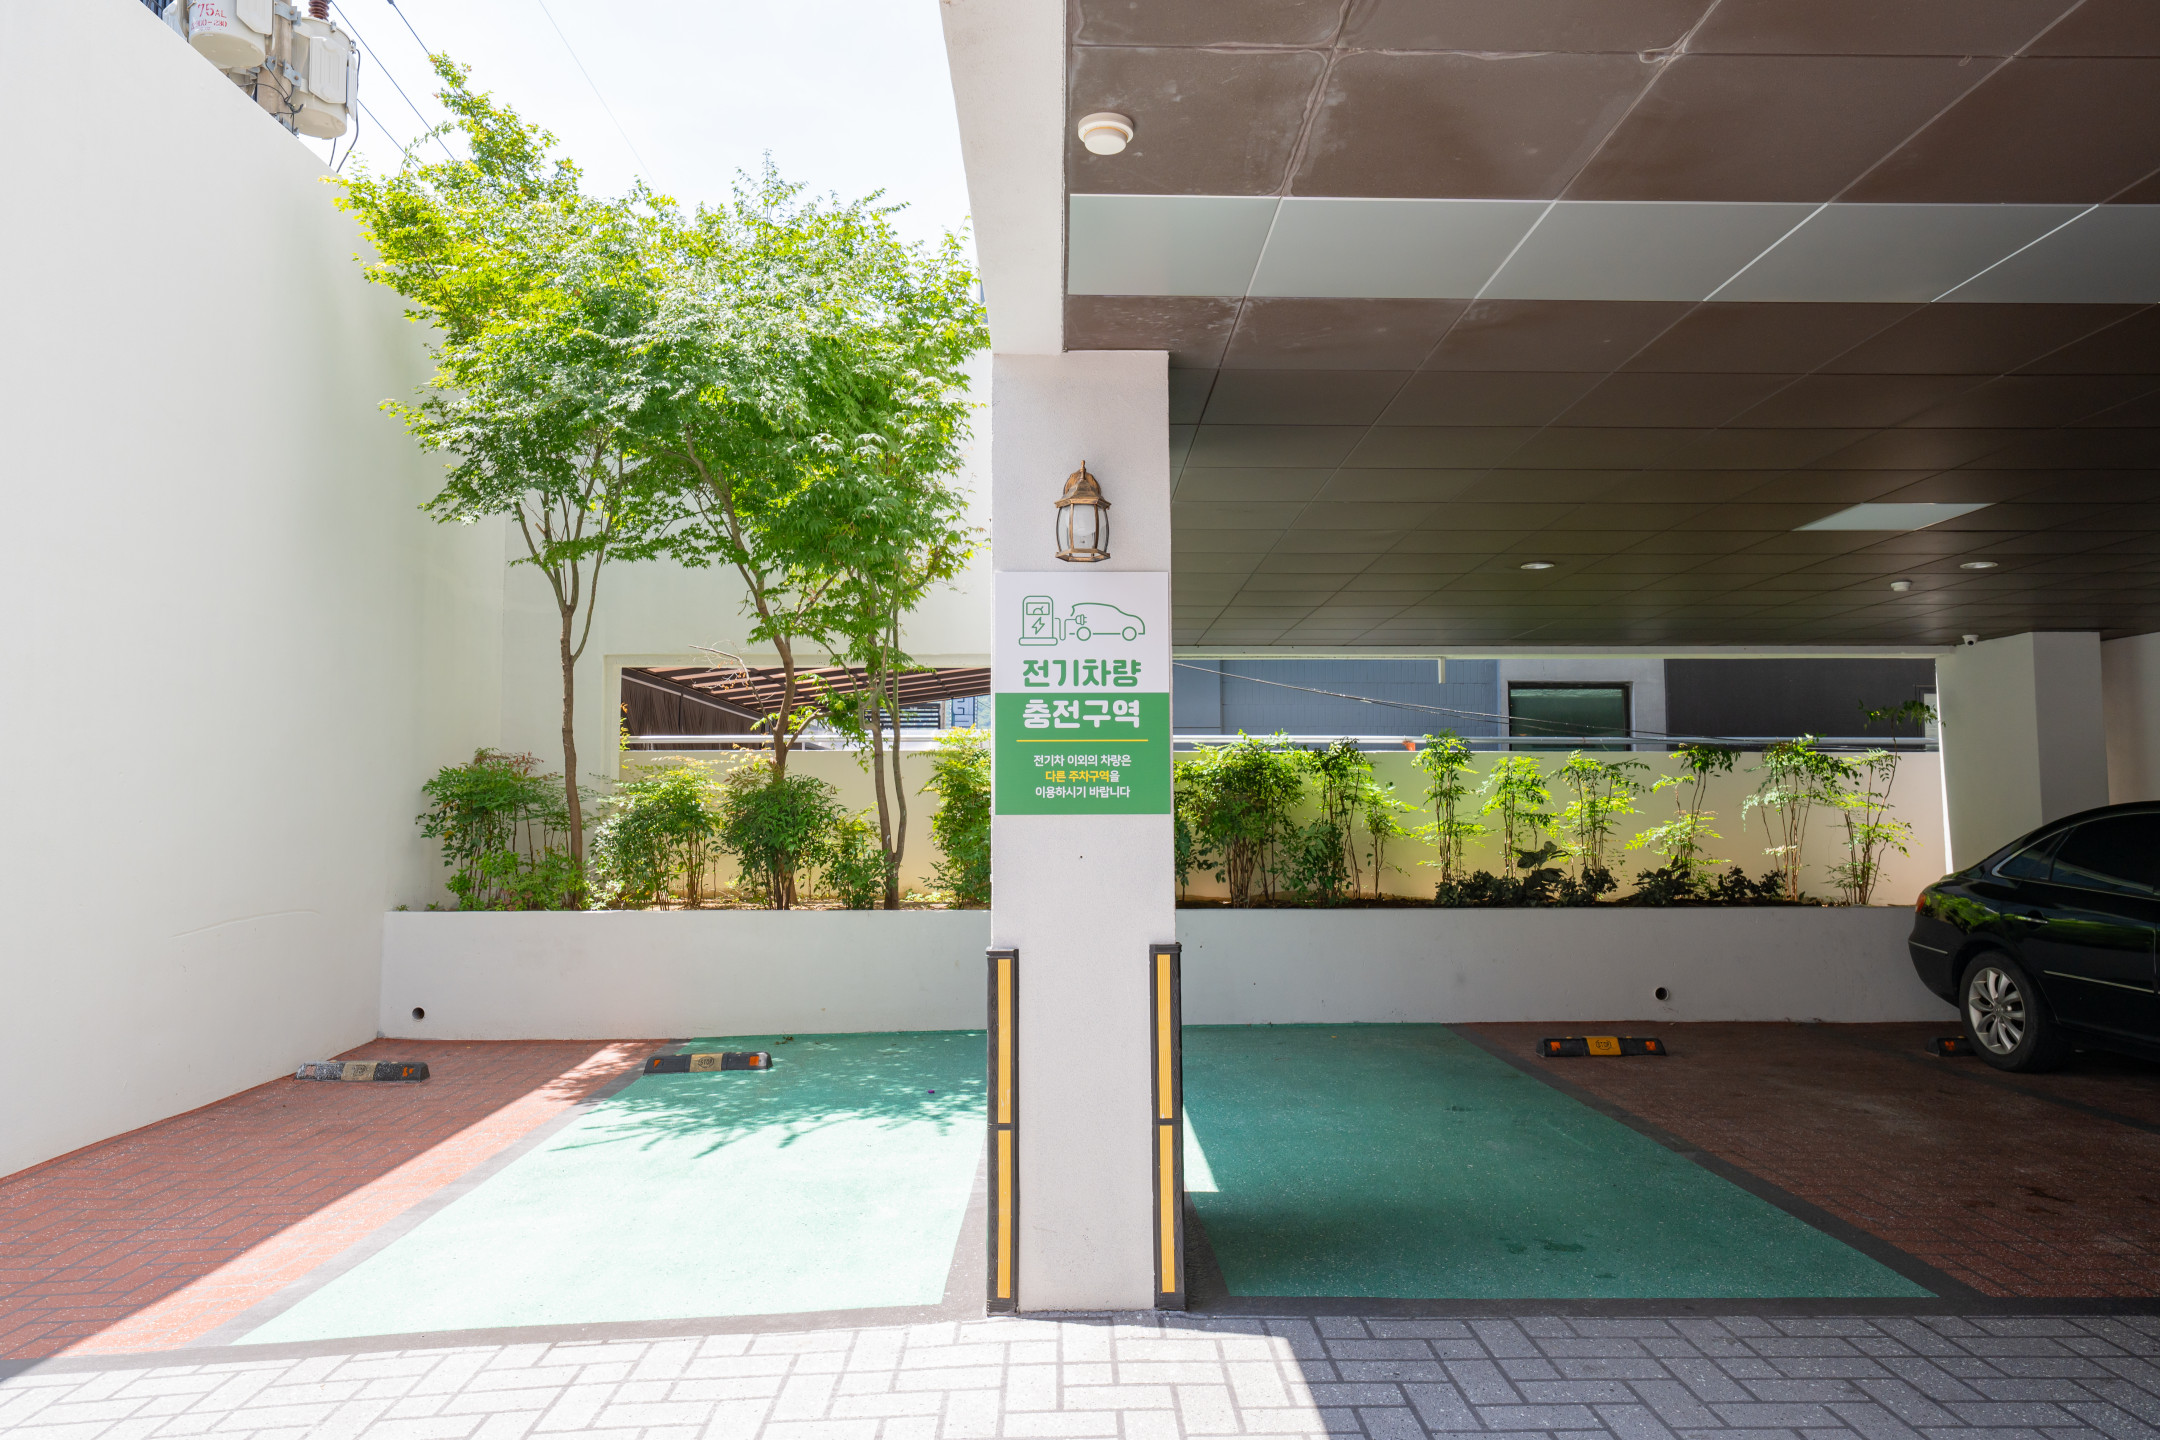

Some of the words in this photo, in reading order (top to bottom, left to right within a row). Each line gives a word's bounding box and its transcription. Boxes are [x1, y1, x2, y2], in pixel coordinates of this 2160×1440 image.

[1023, 658, 1142, 687] 전기차량
[1022, 699, 1140, 729] 충전구역
[1033, 754, 1065, 767] 전기차
[1067, 754, 1098, 767] 이외의
[1100, 754, 1132, 767] 차량은
[1045, 770, 1066, 783] 다른
[1068, 770, 1120, 783] 주차구역을
[1035, 786, 1086, 799] 이용하시기
[1089, 785, 1131, 798] 바랍니다
